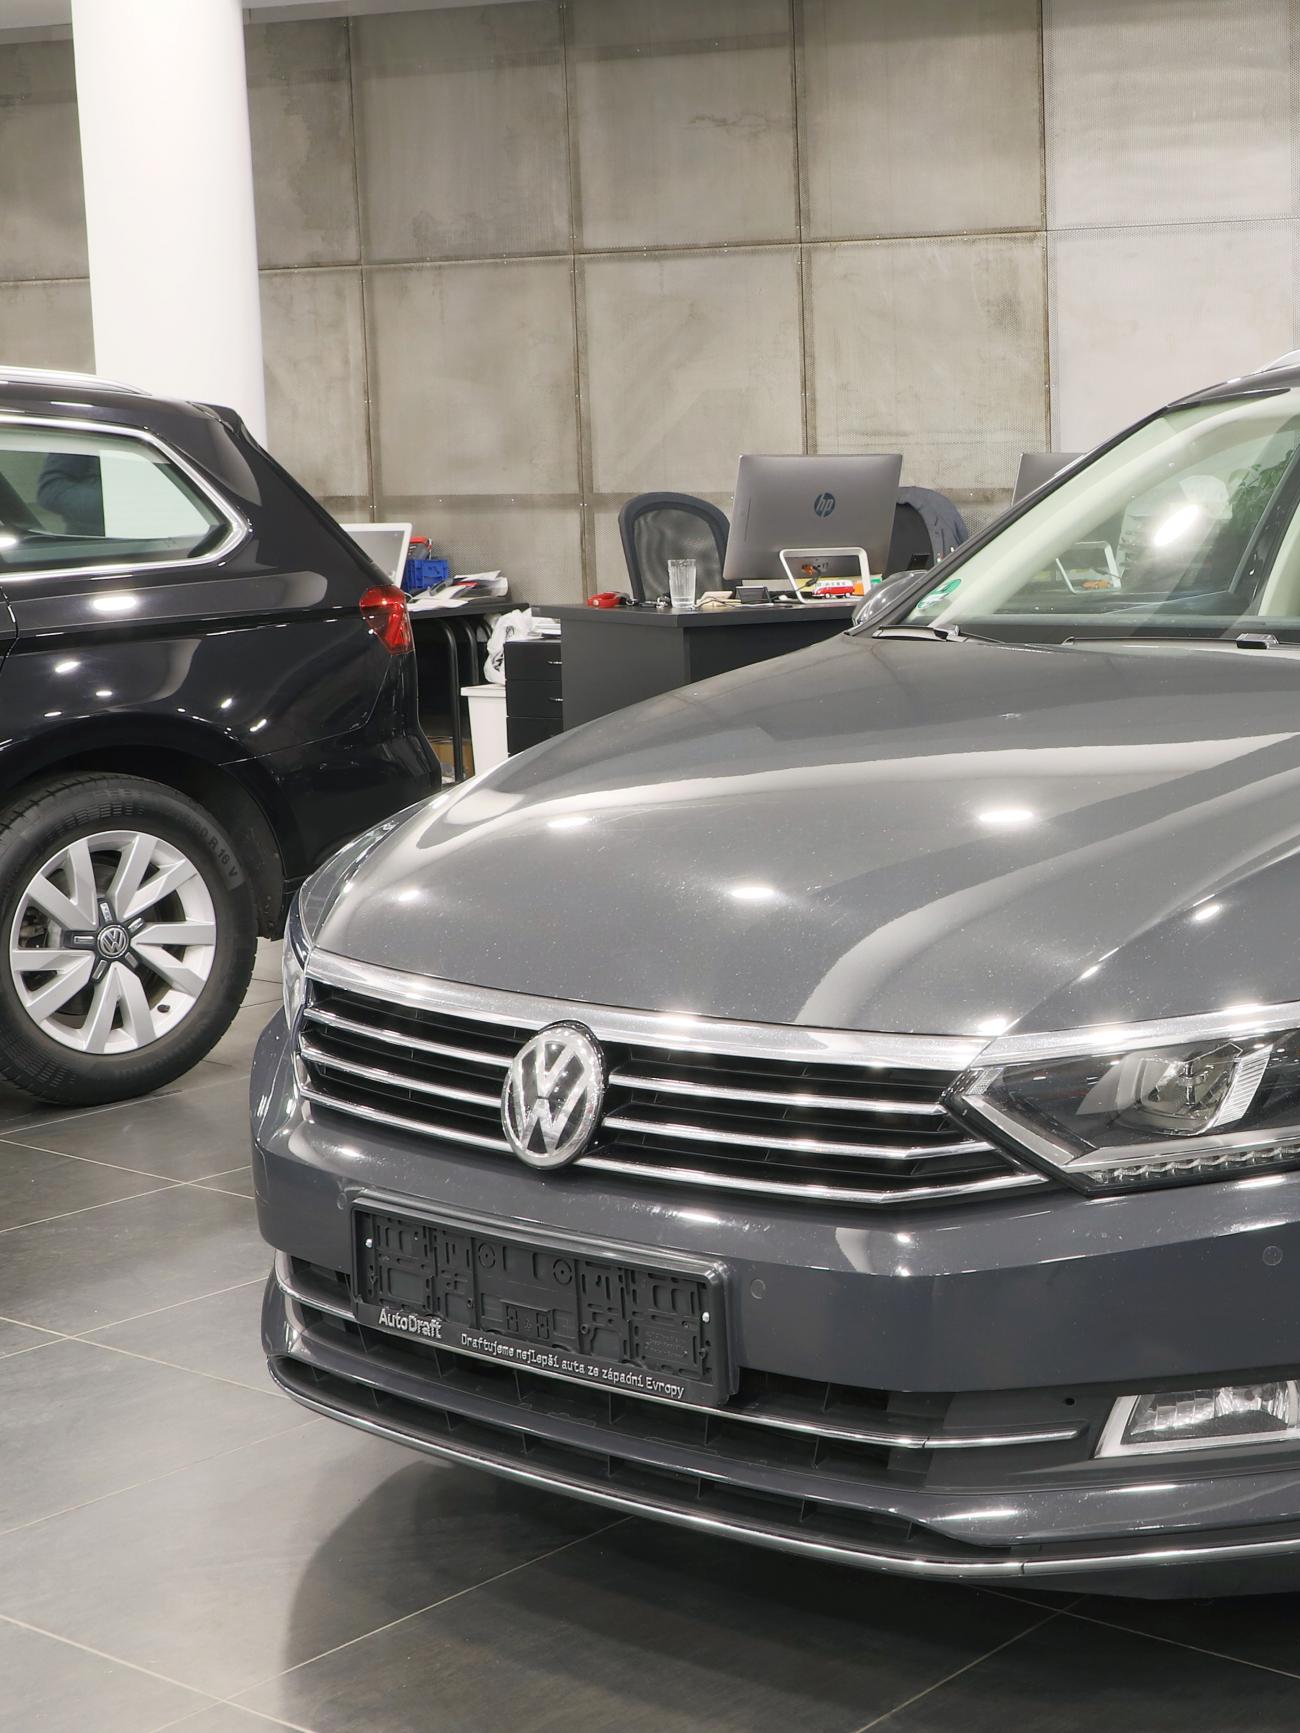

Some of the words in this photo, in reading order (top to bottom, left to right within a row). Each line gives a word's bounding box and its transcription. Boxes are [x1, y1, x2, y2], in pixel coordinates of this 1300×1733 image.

[815, 493, 836, 519] hp
[505, 1031, 598, 1161] VW
[379, 1307, 443, 1340] AutoDraft
[460, 1333, 514, 1357] Draftujeme
[516, 1348, 560, 1368] nejlepší
[561, 1360, 586, 1374] auta
[587, 1365, 599, 1377] ze
[601, 1367, 644, 1387] západní
[645, 1376, 685, 1399] Evropy
